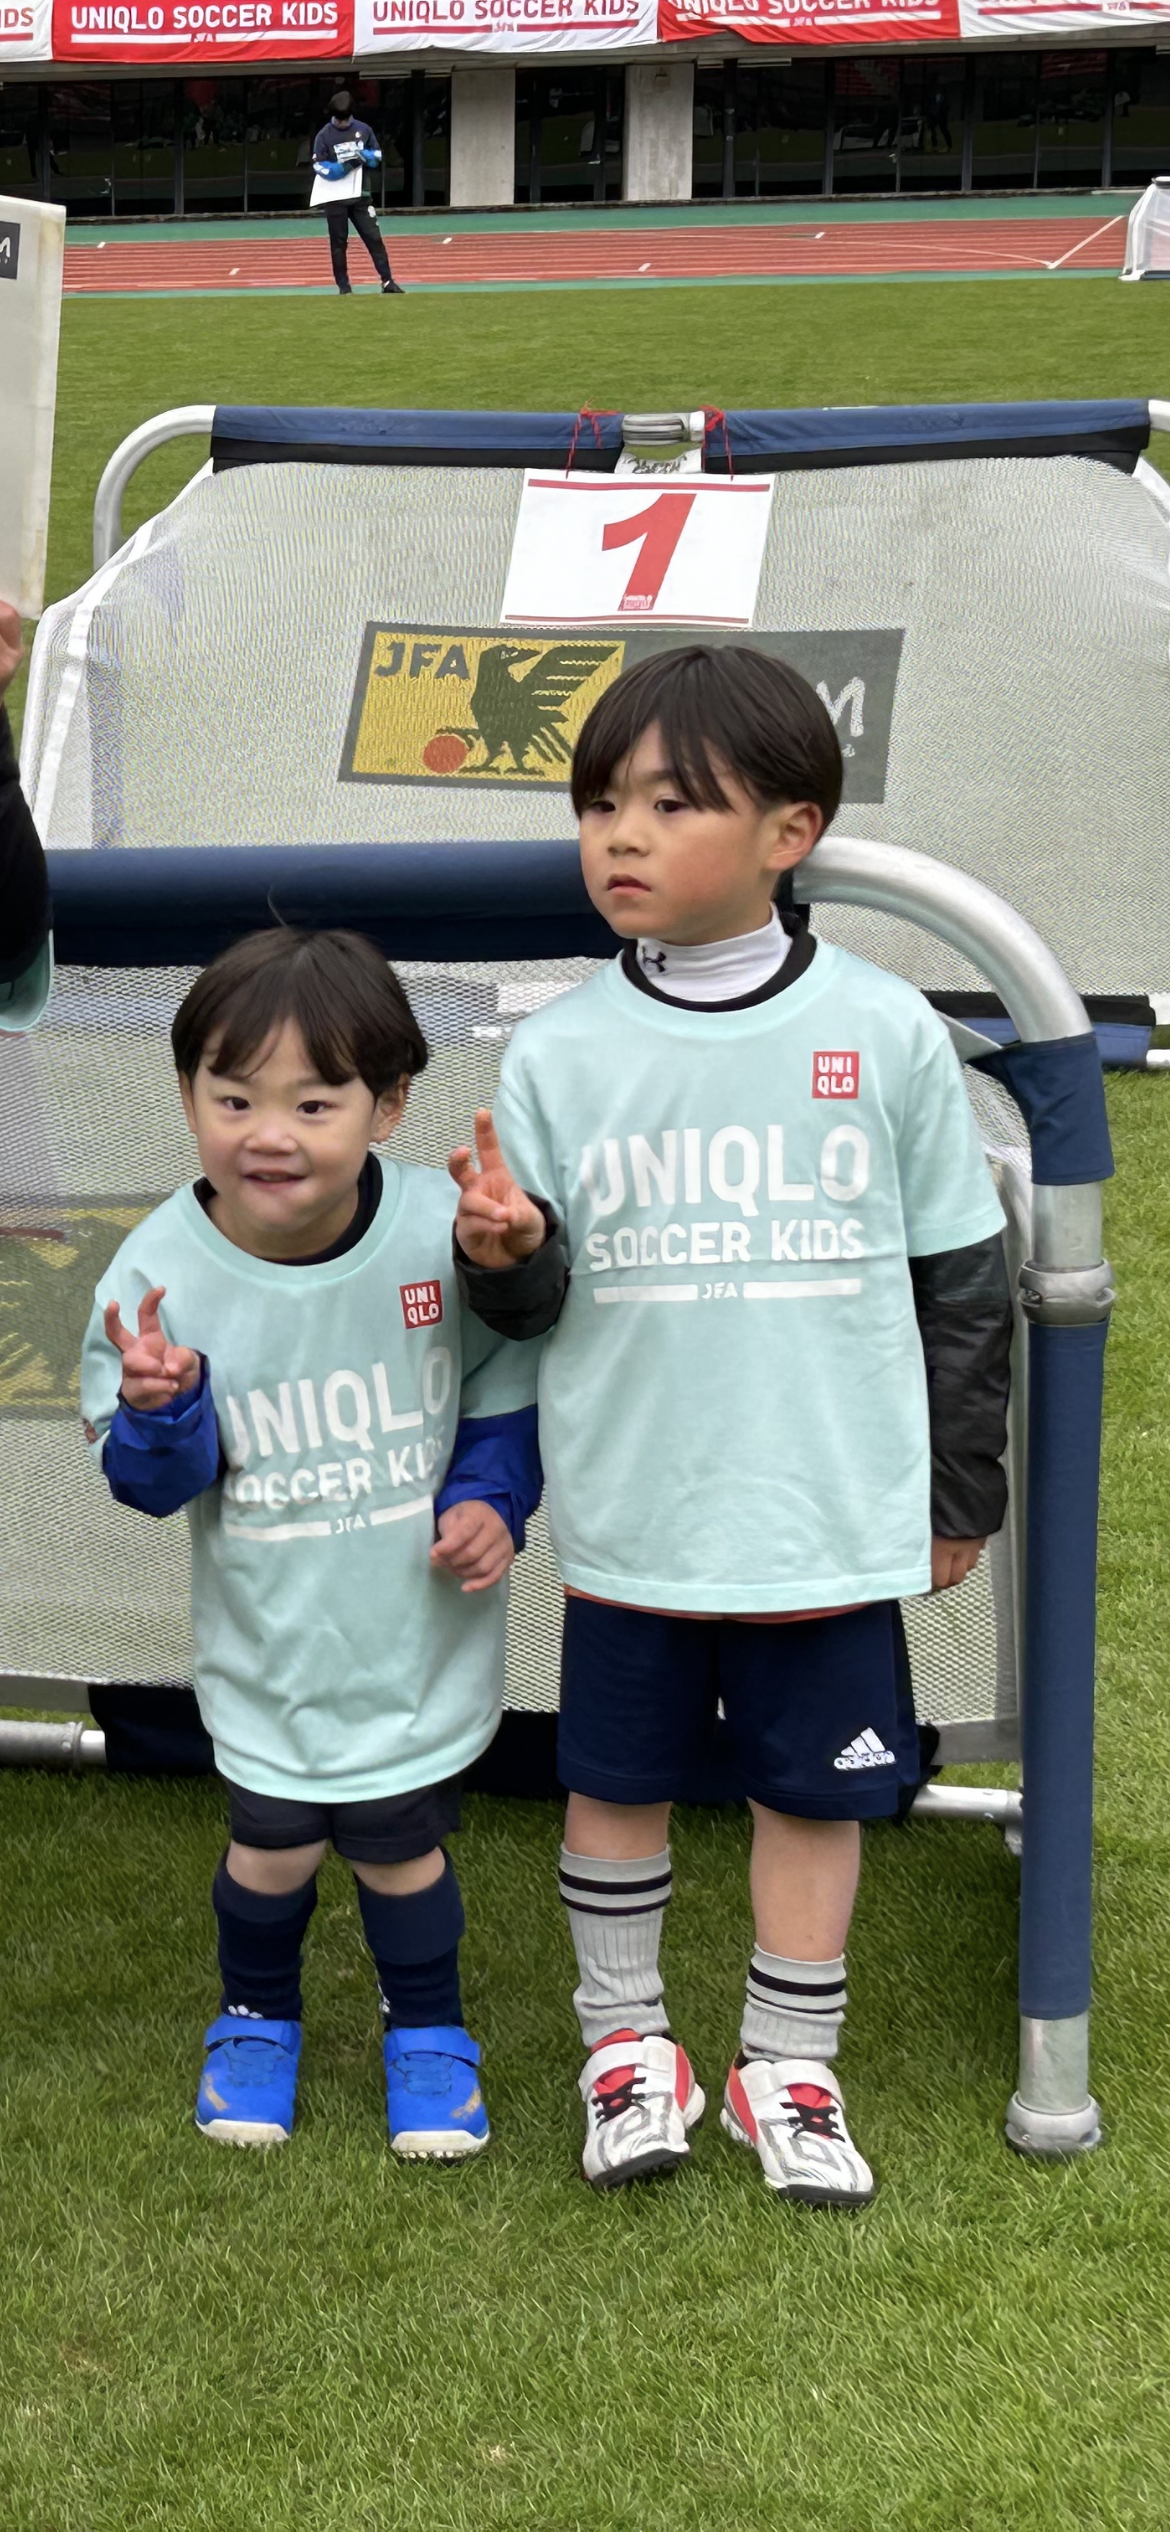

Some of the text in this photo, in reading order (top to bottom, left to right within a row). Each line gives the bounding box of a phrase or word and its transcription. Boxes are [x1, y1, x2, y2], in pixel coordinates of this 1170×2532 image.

[71, 2, 338, 33] UNIQLO SOCCER KIDS
[373, 0, 465, 23] UNIQLO
[475, 0, 572, 20] SOCCER
[601, 493, 697, 611] 1
[374, 641, 470, 681] JFA
[818, 1056, 853, 1074] UNI
[817, 1075, 855, 1096] QLO
[581, 1124, 871, 1217] UNIQLO
[585, 1218, 865, 1273] SOCCER KIDS
[404, 1285, 437, 1305] UNI
[702, 1282, 739, 1299] JFA
[407, 1303, 440, 1325] QLO
